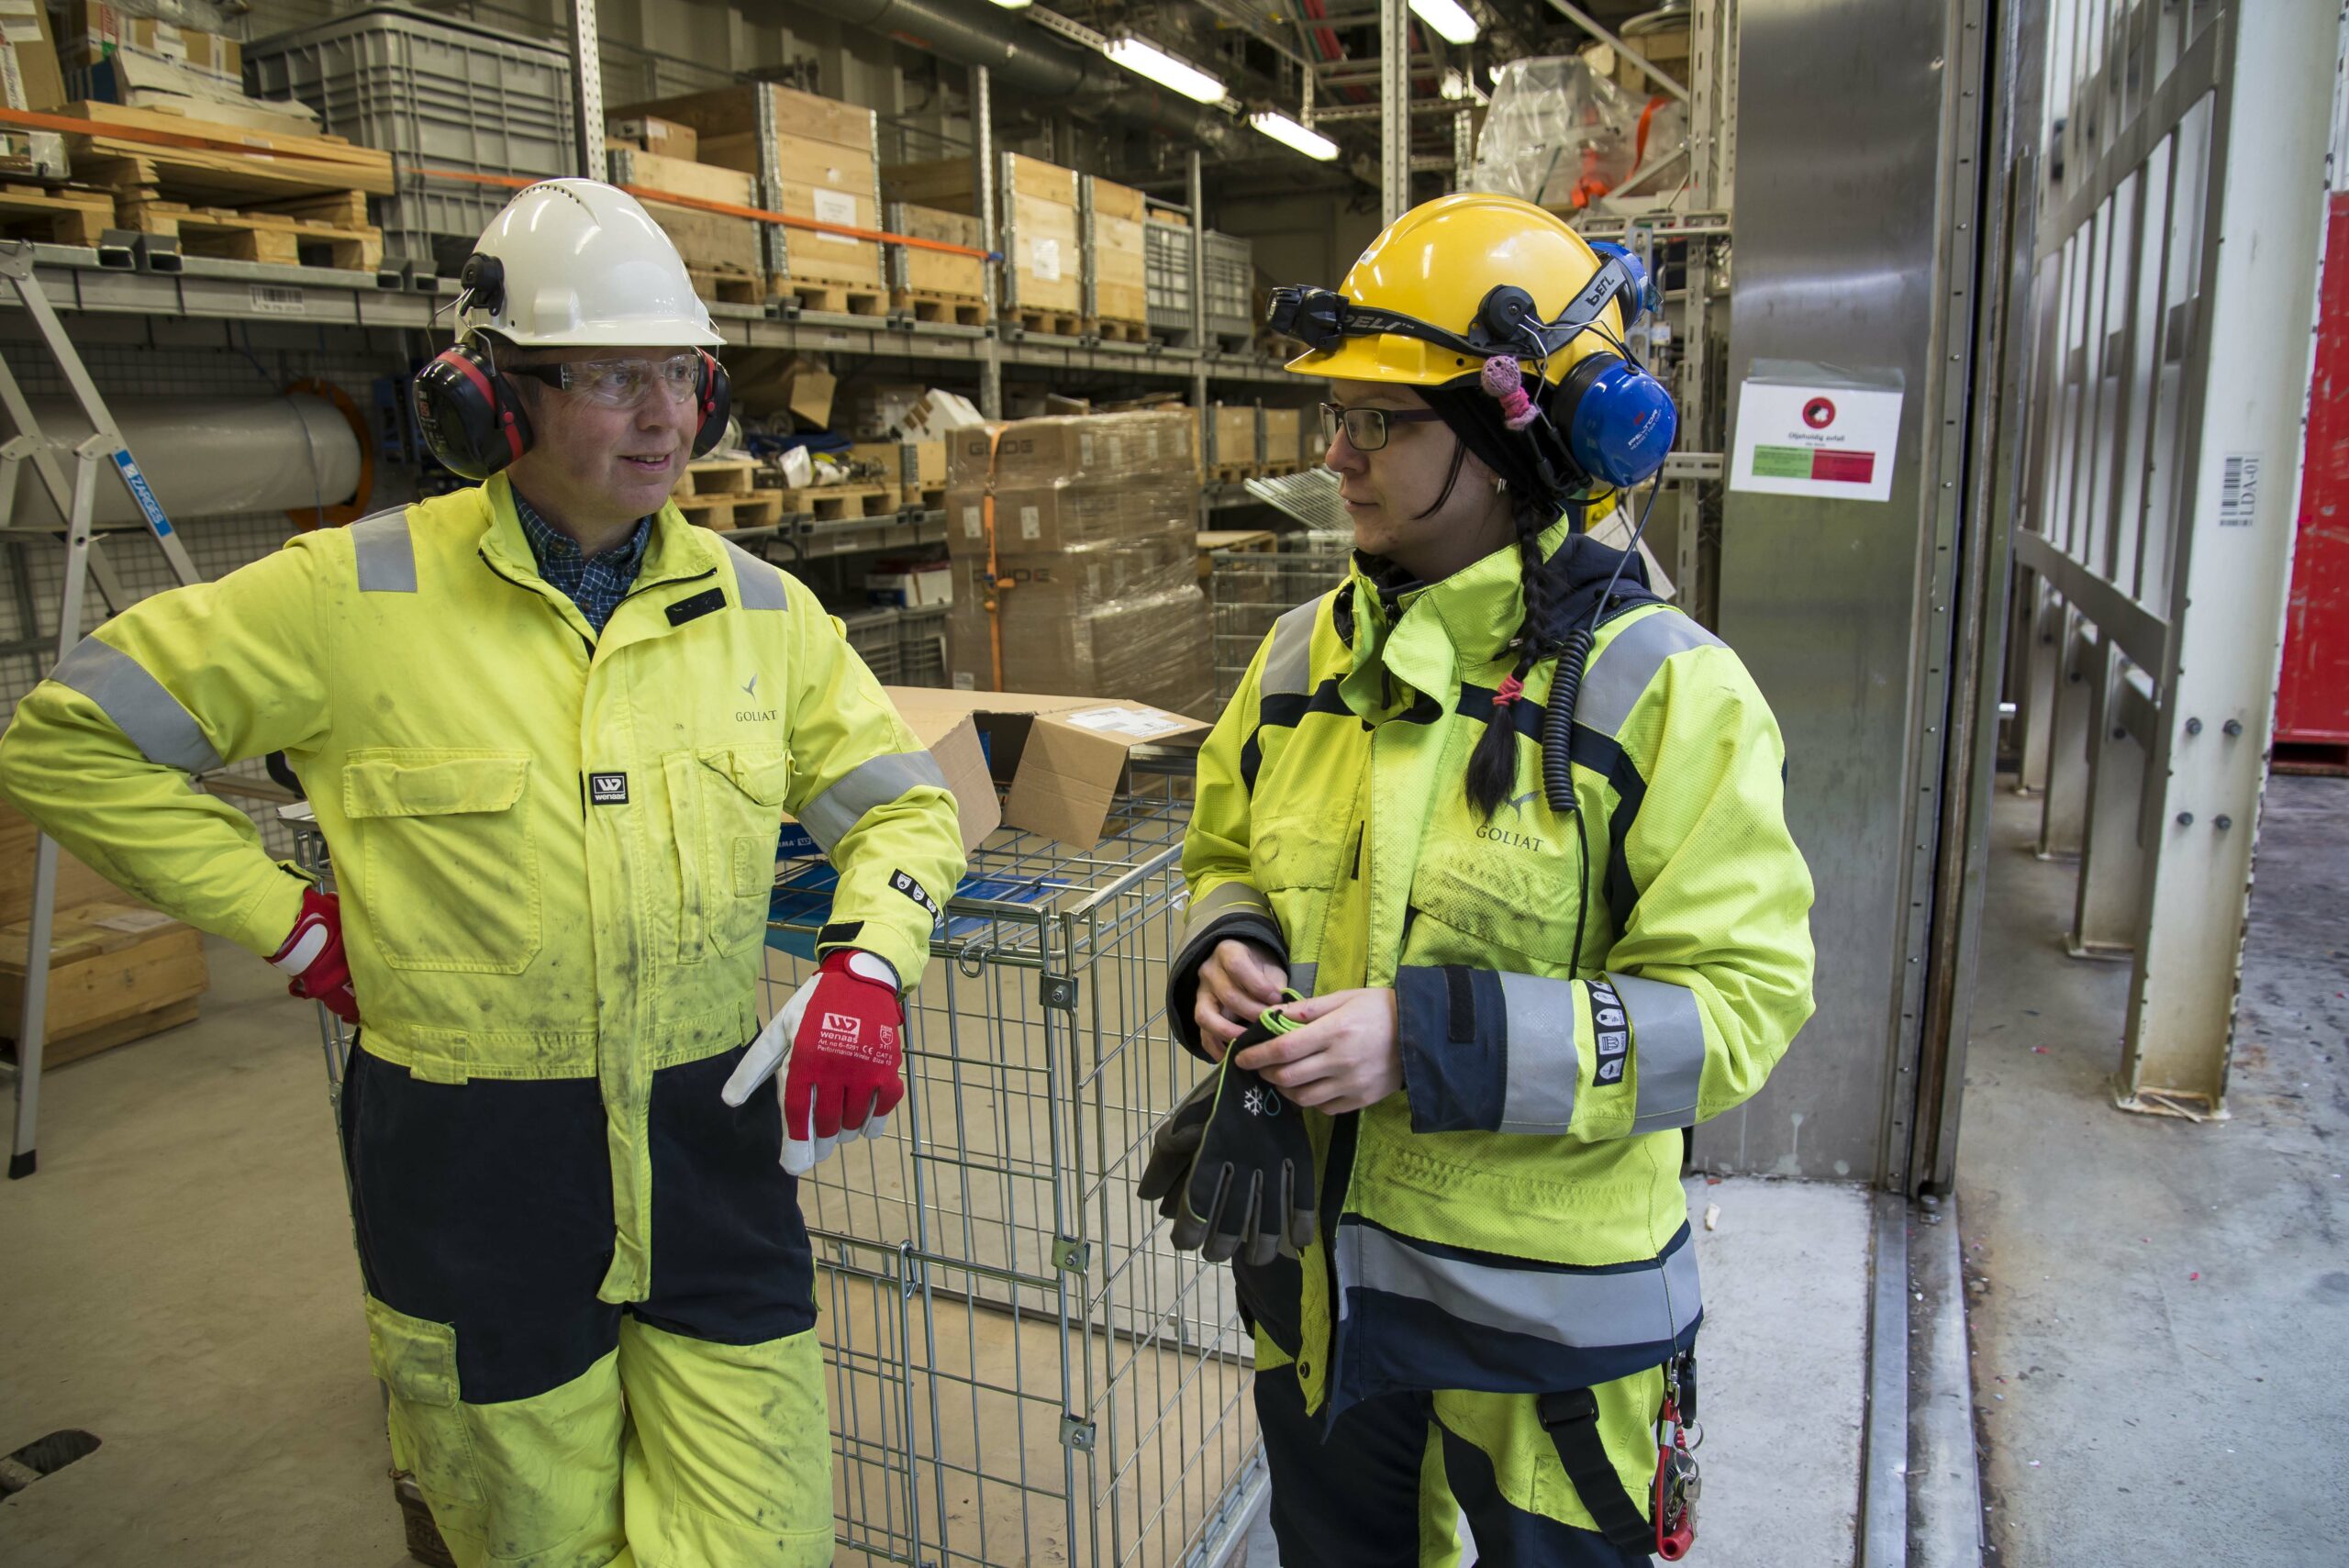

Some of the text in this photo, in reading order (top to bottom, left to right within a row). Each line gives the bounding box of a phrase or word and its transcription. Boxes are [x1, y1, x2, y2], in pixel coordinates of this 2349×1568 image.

[1628, 408, 1658, 446] PELTOR
[735, 710, 777, 722] GOLIAT
[1475, 825, 1543, 851] GOLIAT
[820, 1030, 859, 1044] wenaas
[817, 1044, 853, 1057] Performance
